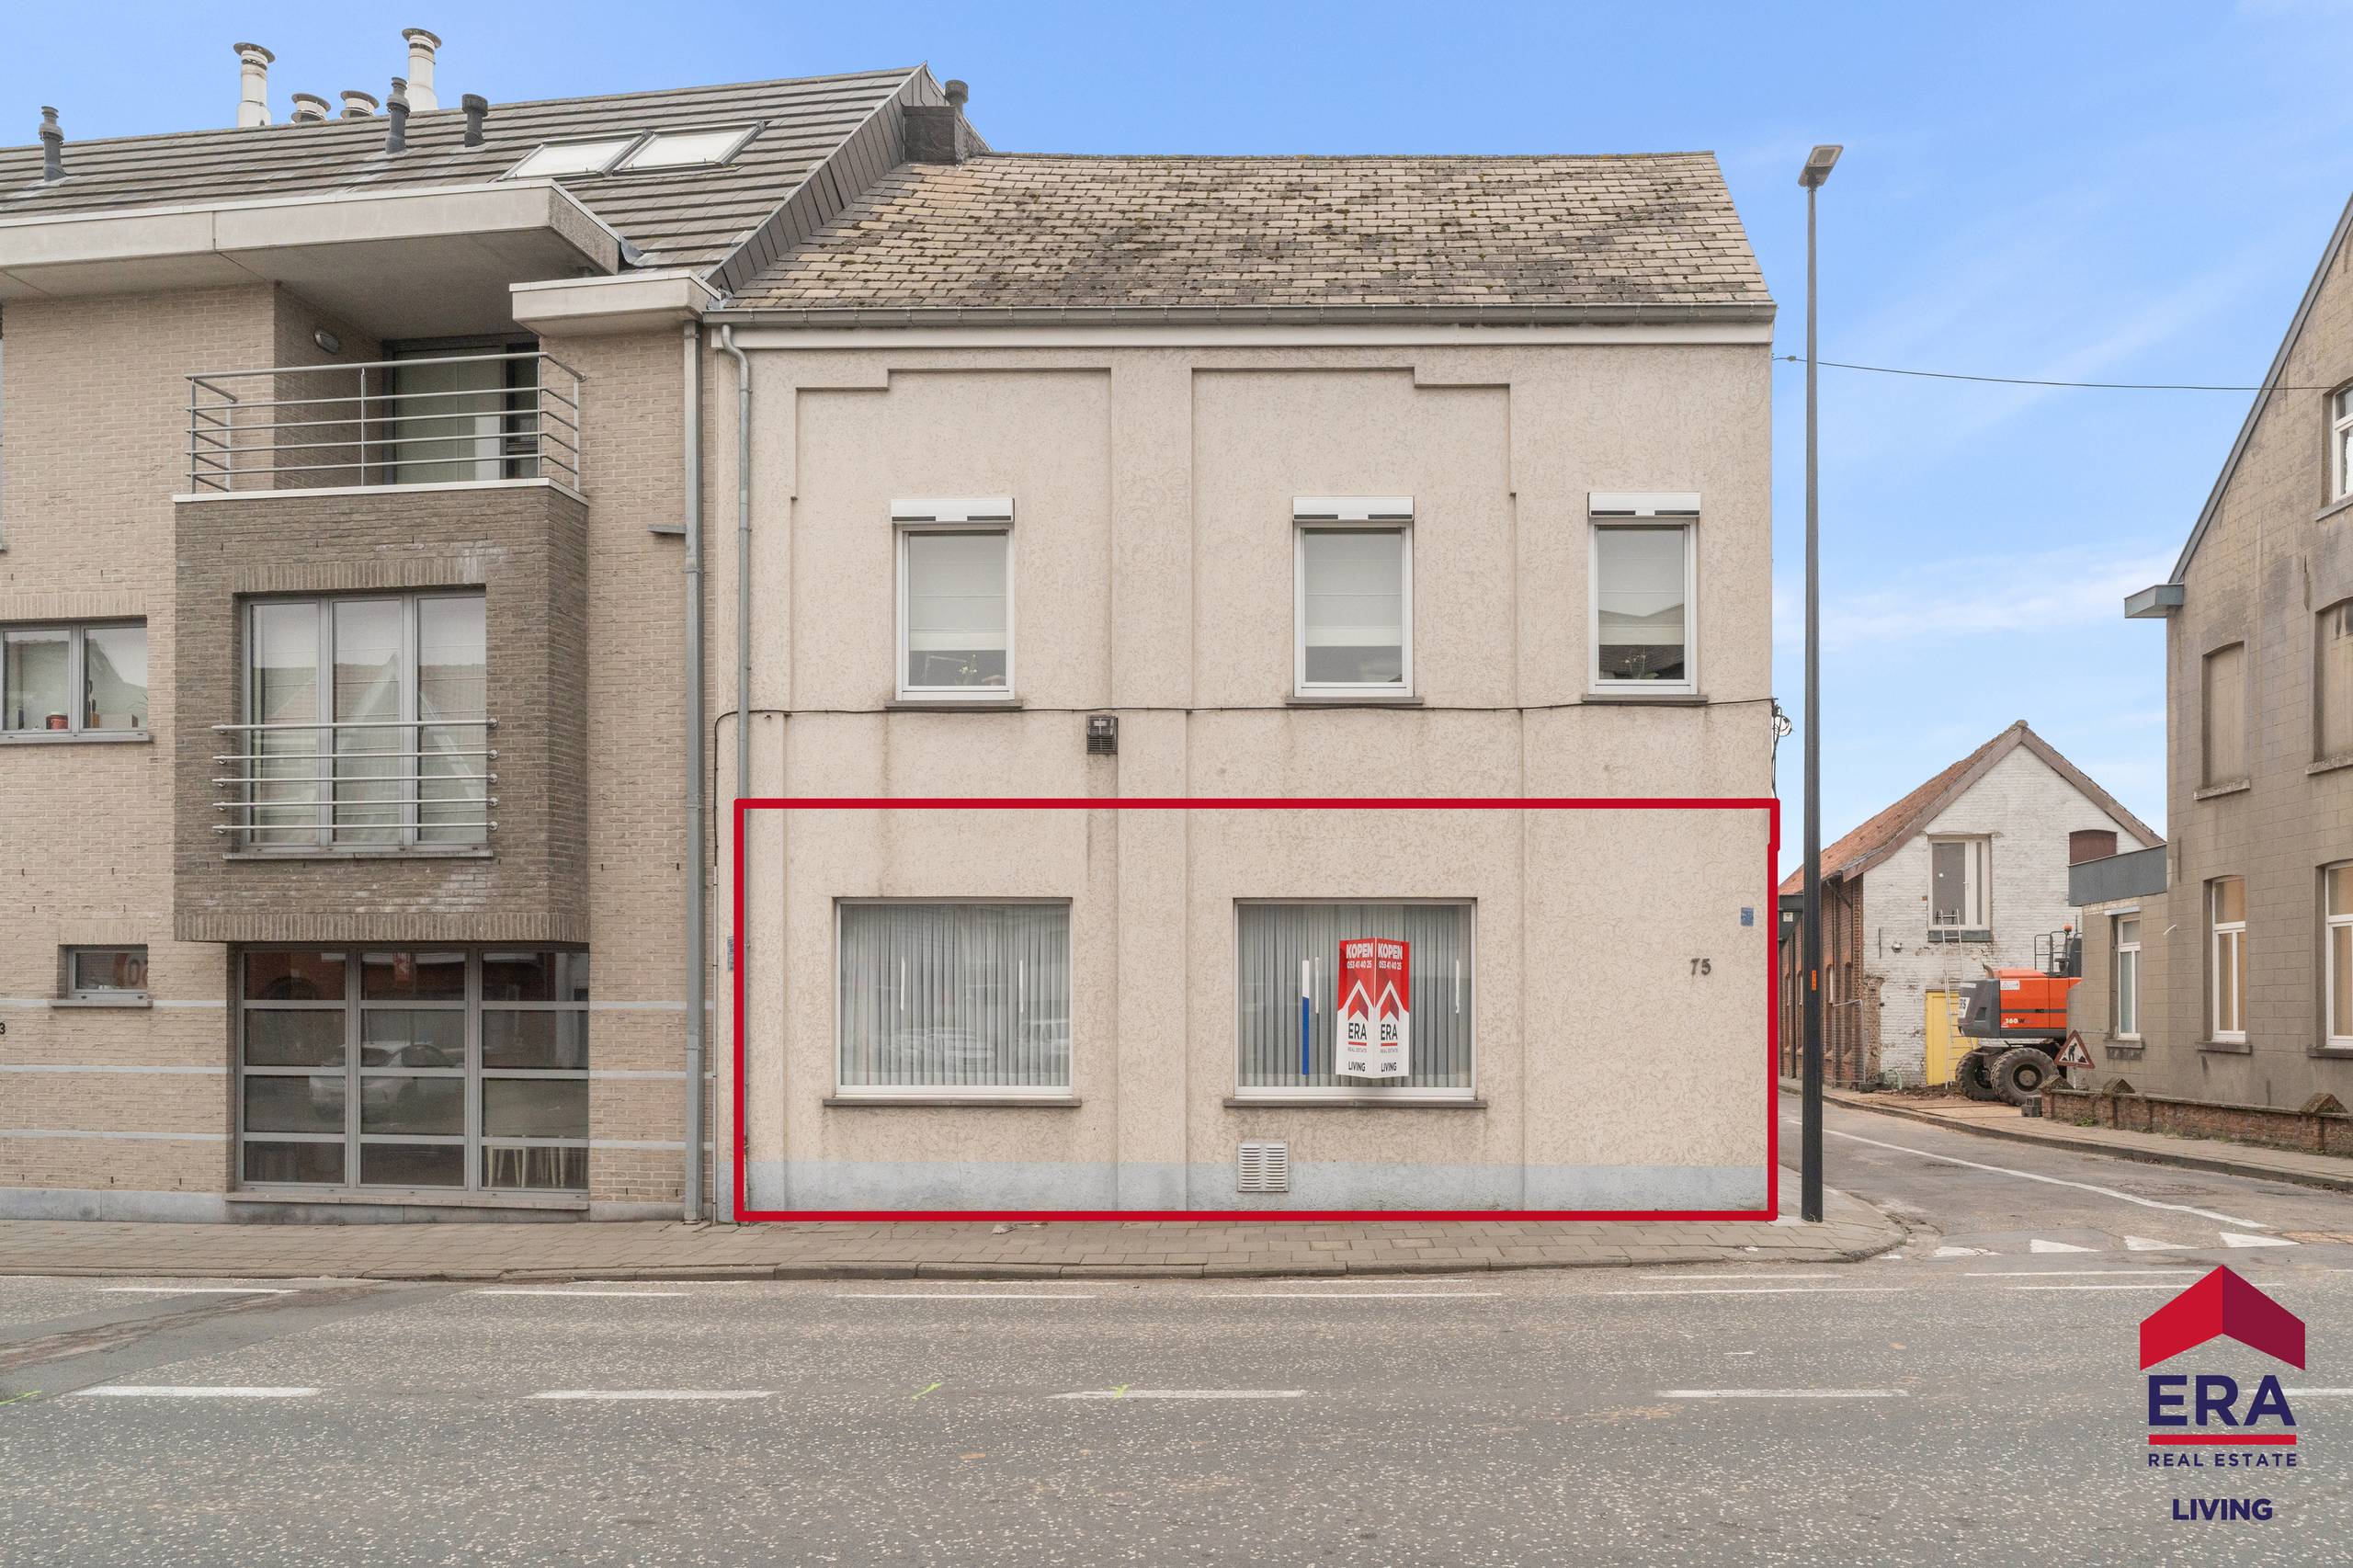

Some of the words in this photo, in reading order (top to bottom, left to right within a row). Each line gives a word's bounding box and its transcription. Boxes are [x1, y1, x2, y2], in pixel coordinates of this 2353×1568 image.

[1347, 943, 1373, 959] KOPEN
[1378, 943, 1403, 960] KOPEN
[1690, 958, 1711, 975] 75
[1348, 1023, 1367, 1040] ERA
[1381, 1024, 1397, 1040] ERA
[1348, 1061, 1366, 1072] LIVING
[1381, 1062, 1397, 1073] LIVING
